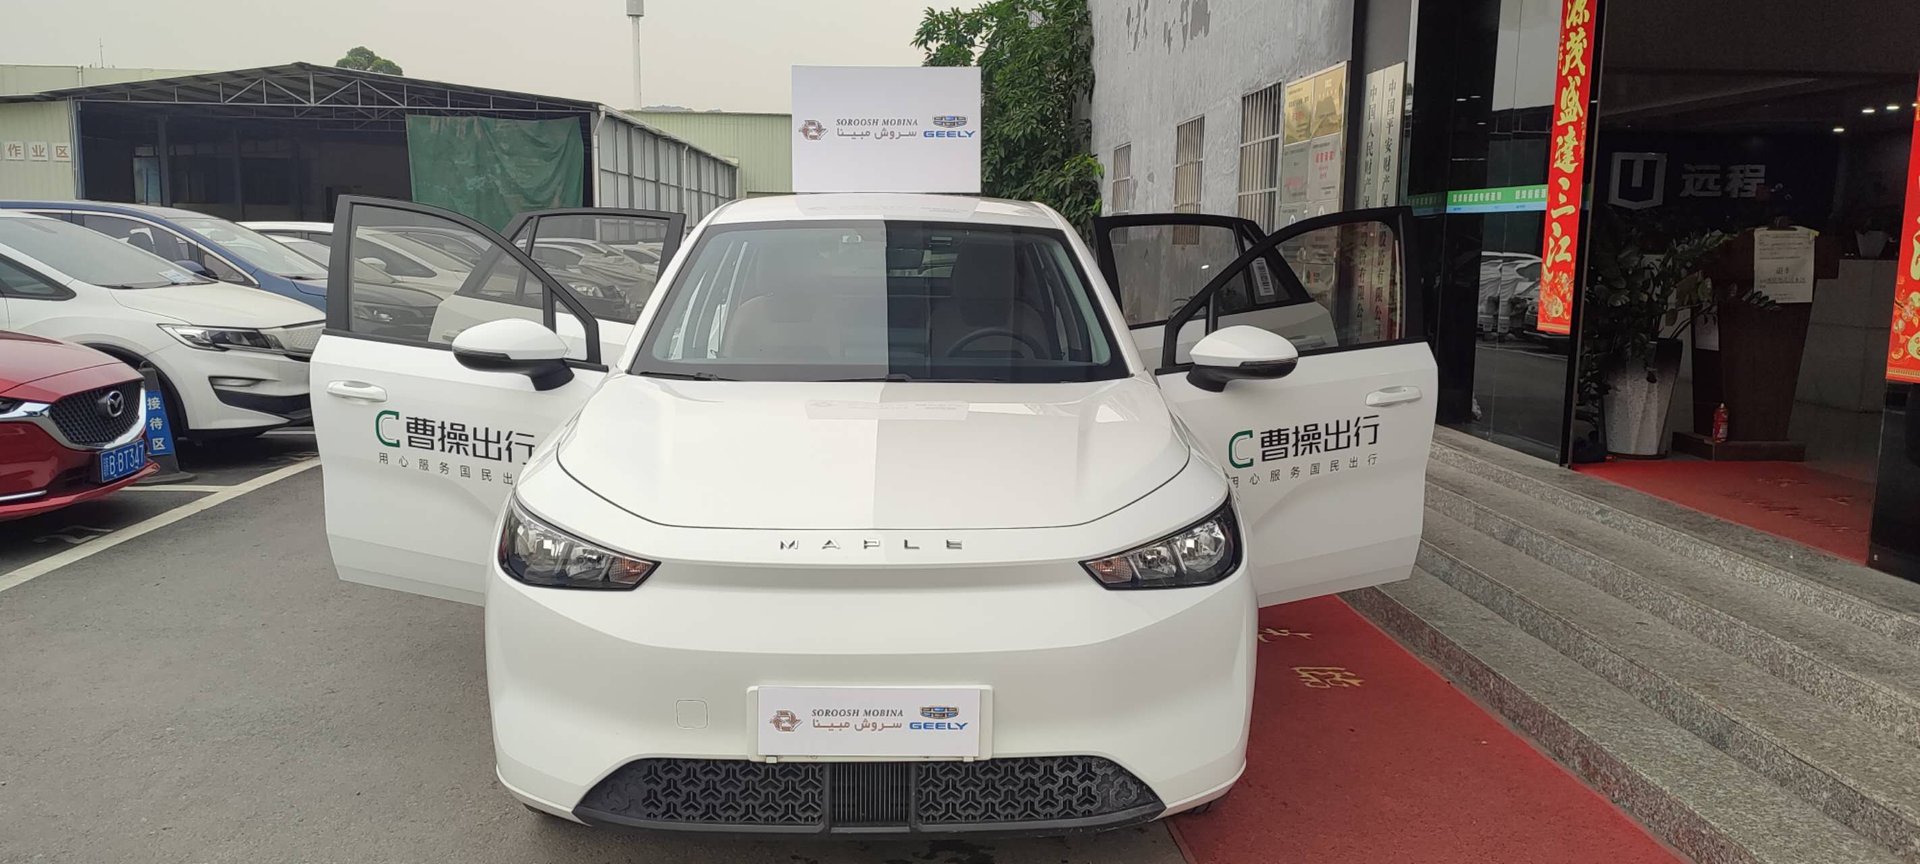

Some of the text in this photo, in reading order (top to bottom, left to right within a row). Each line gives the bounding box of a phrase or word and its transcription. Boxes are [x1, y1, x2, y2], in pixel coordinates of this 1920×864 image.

[836, 118, 918, 127] SOROOSH MOBINA
[923, 130, 976, 138] GEELY
[8, 143, 70, 158] 作业区
[1679, 163, 1766, 199] 远程
[147, 396, 166, 451] 接待区
[405, 416, 536, 465] 曹操出行
[1260, 414, 1380, 462] 曹操出行
[779, 539, 963, 550] MAPLE
[811, 708, 904, 717] SOROOSH MOBINA
[909, 721, 968, 731] GEELY
